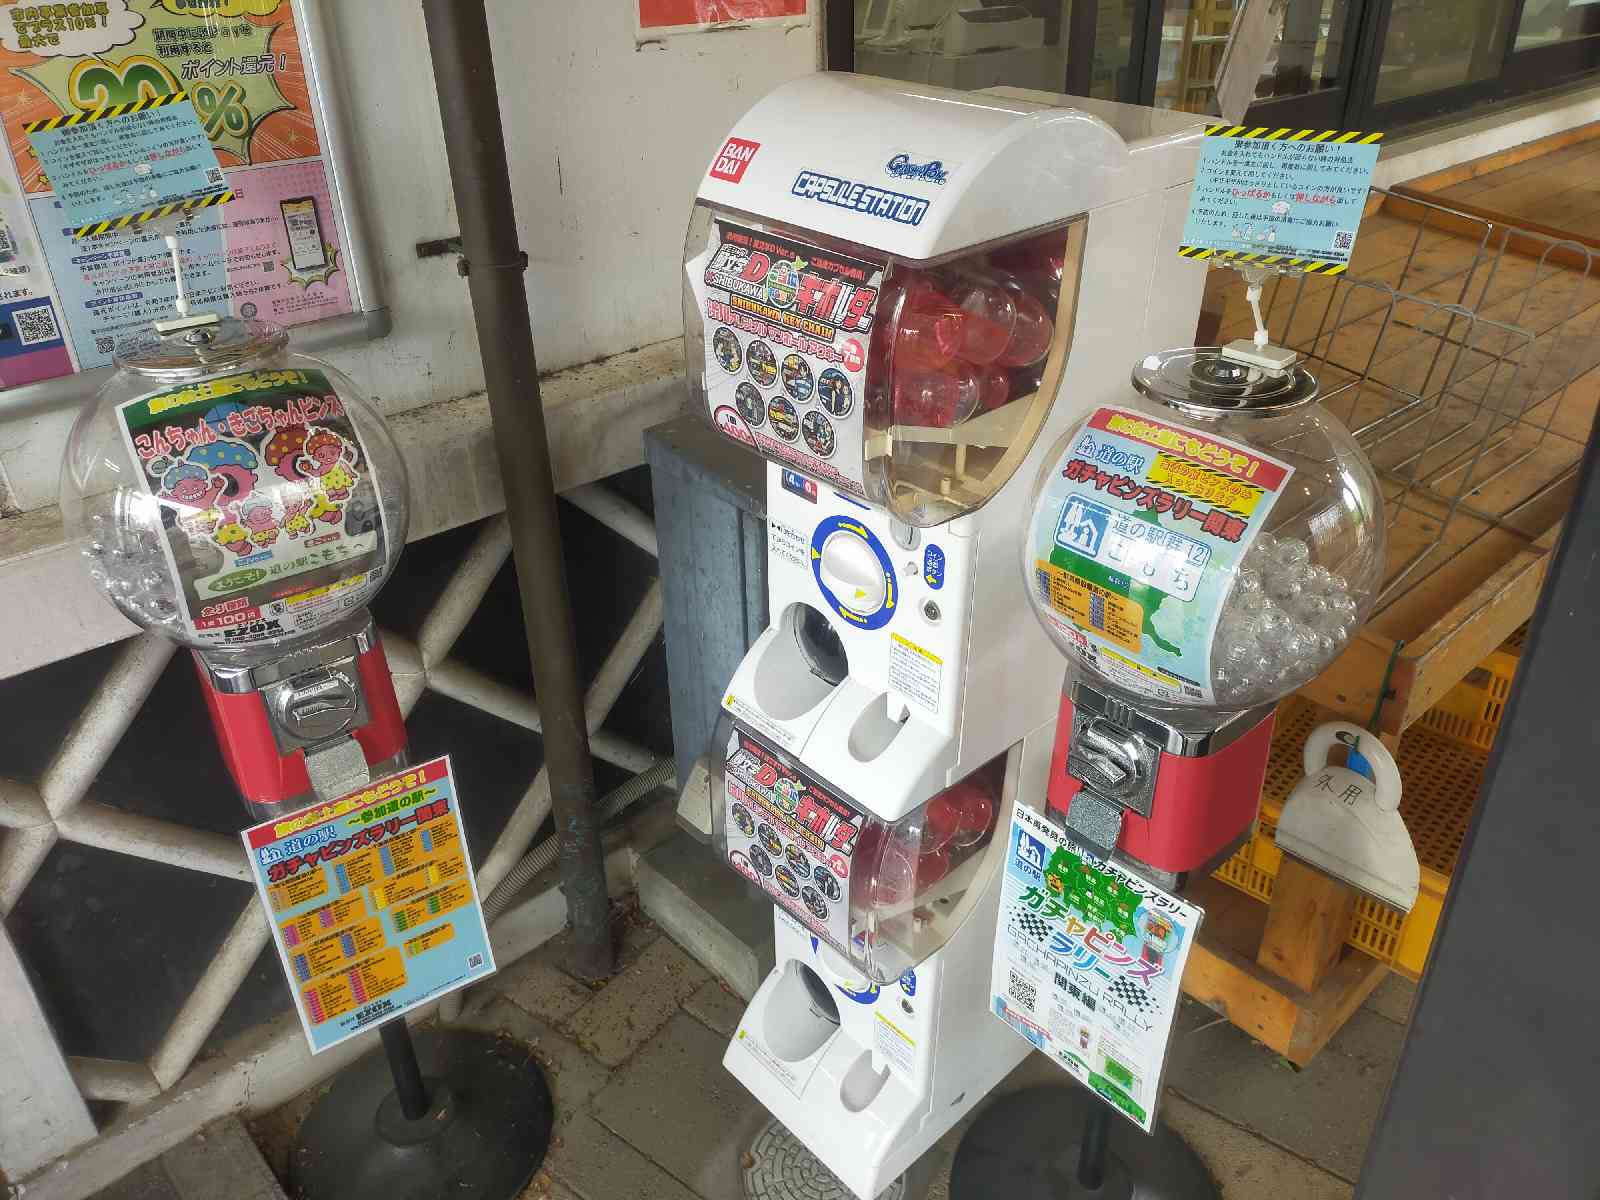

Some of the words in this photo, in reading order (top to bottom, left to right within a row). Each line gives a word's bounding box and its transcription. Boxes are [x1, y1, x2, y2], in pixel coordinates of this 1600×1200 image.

[181, 54, 286, 80] ポイント還元！
[715, 157, 740, 176] DAI
[723, 143, 754, 162] BAN
[792, 170, 860, 211] CAPSULE
[858, 184, 930, 225] STATION
[713, 273, 768, 303] SHIBUKAWA
[1097, 442, 1145, 475] 道の駅
[1112, 512, 1164, 547] 道の駅
[285, 825, 336, 857] 道の駅
[1015, 859, 1041, 882] 道の駅
[1019, 884, 1165, 987] ガチャピンズ
[1049, 930, 1113, 981] ラリー
[1054, 971, 1097, 1013] 関東編
